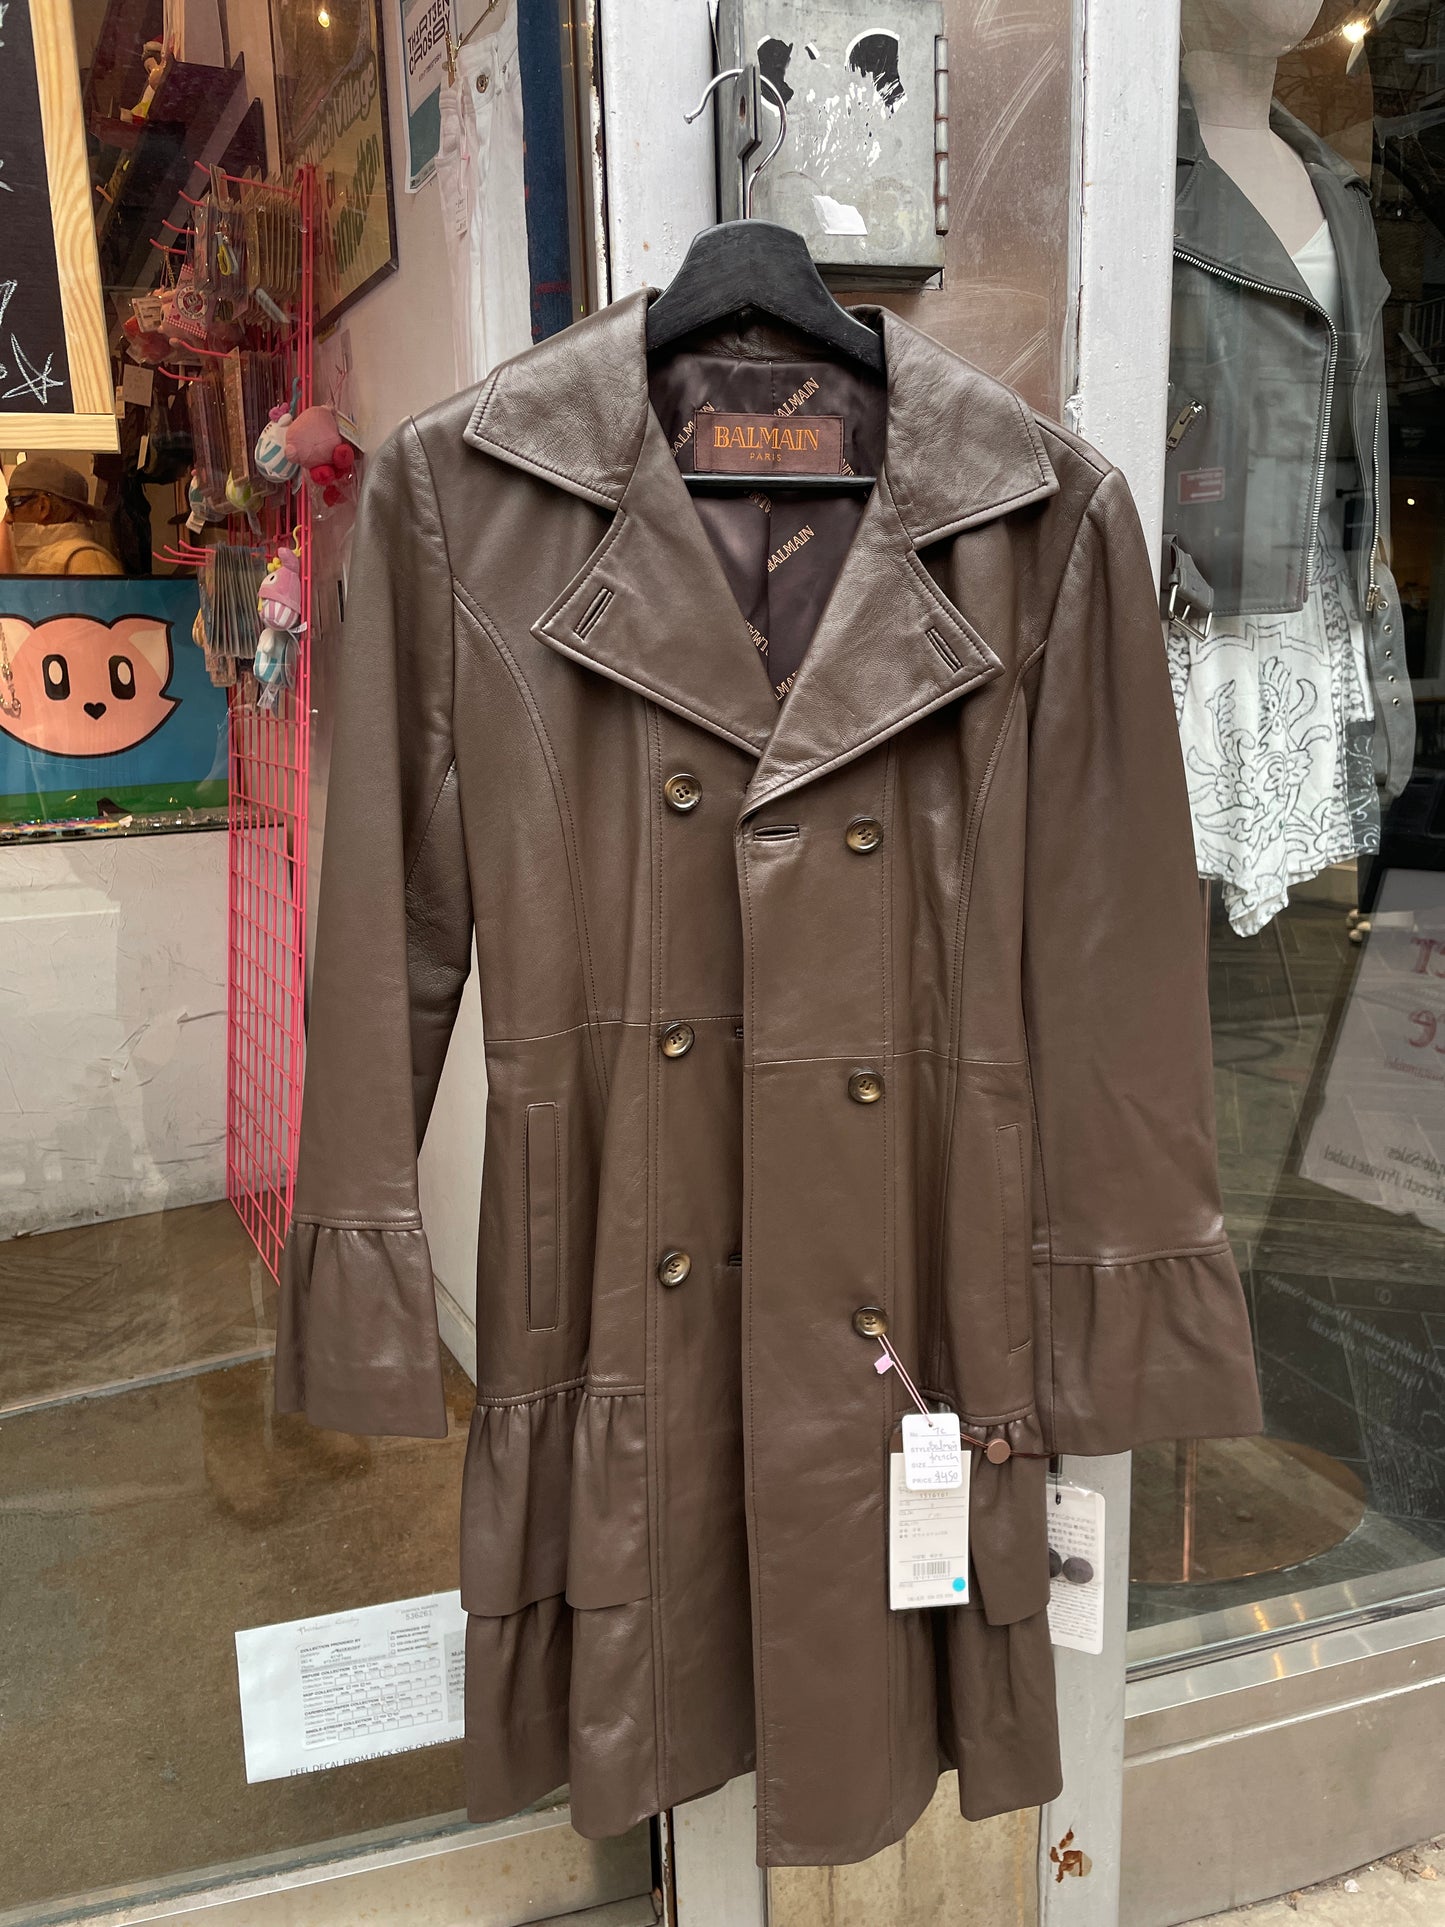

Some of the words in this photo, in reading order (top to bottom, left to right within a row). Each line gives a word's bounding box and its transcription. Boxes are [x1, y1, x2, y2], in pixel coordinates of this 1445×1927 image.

[333, 61, 376, 137] Village
[774, 377, 820, 417] ALMAIN
[714, 426, 820, 451] BALMAIN
[749, 453, 782, 462] PARIS
[934, 1470, 958, 1484] $450
[290, 1765, 309, 1777] PEEL
[312, 1760, 341, 1773] DECAL
[342, 1754, 369, 1767] FROM
